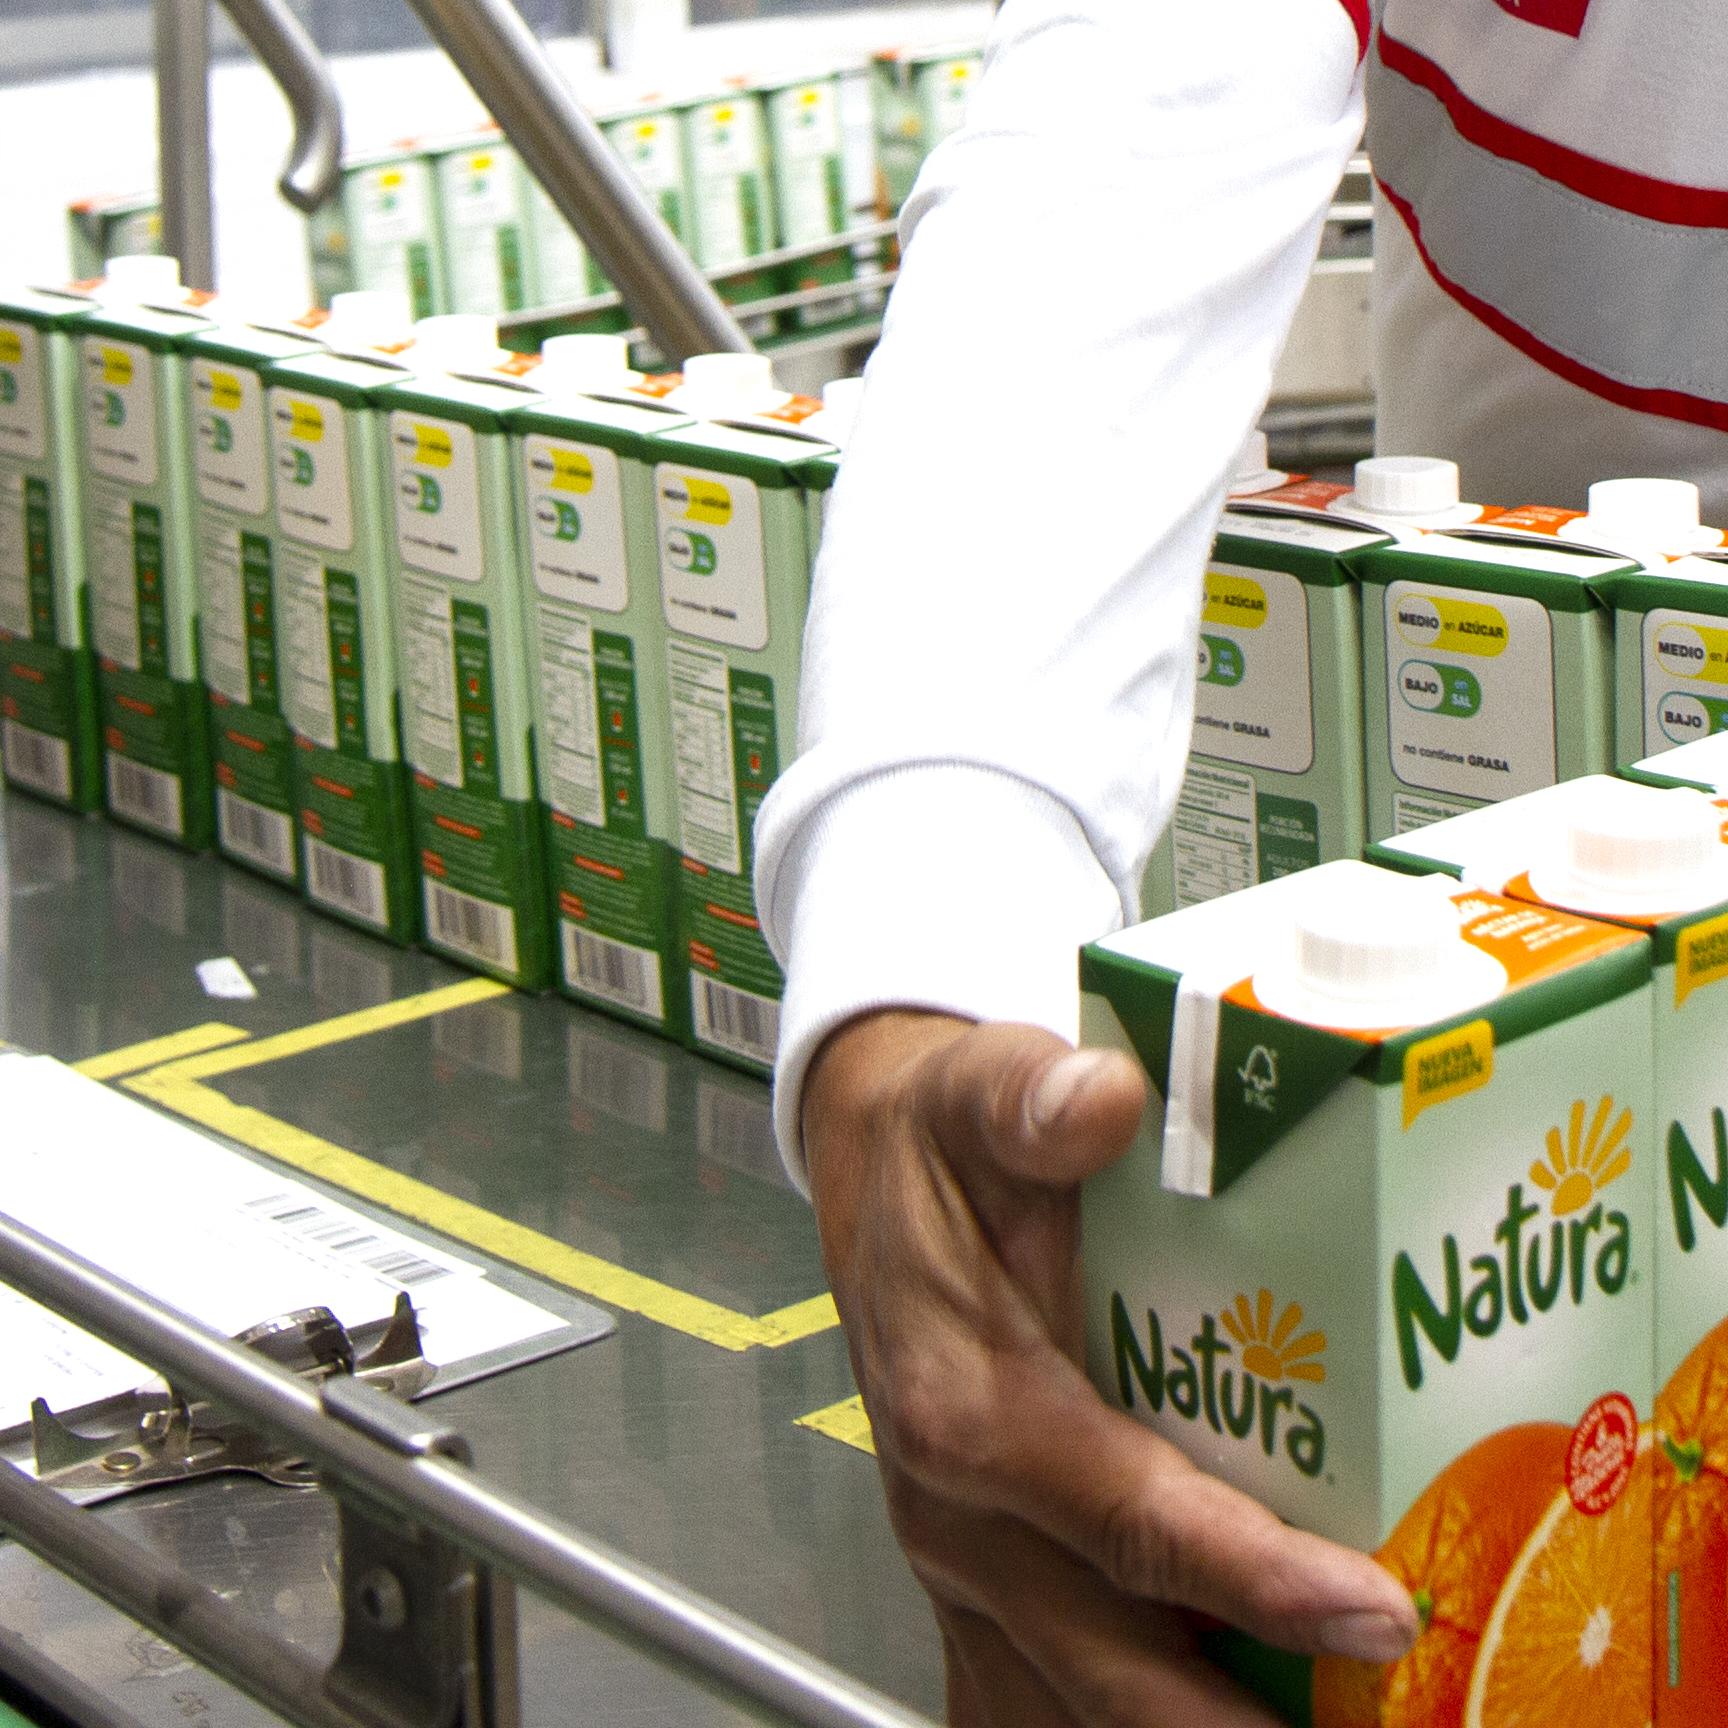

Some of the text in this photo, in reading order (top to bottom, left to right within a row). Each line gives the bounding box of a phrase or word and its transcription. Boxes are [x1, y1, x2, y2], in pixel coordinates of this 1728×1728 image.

[1398, 611, 1439, 630] MEDIO
[1658, 641, 1704, 661] MEDIO
[1405, 678, 1439, 695] BAJO
[1664, 710, 1702, 729] BAJO
[1467, 754, 1511, 772] GRASA
[1390, 1185, 1634, 1390] Natura
[1110, 1290, 1326, 1476] Natura
